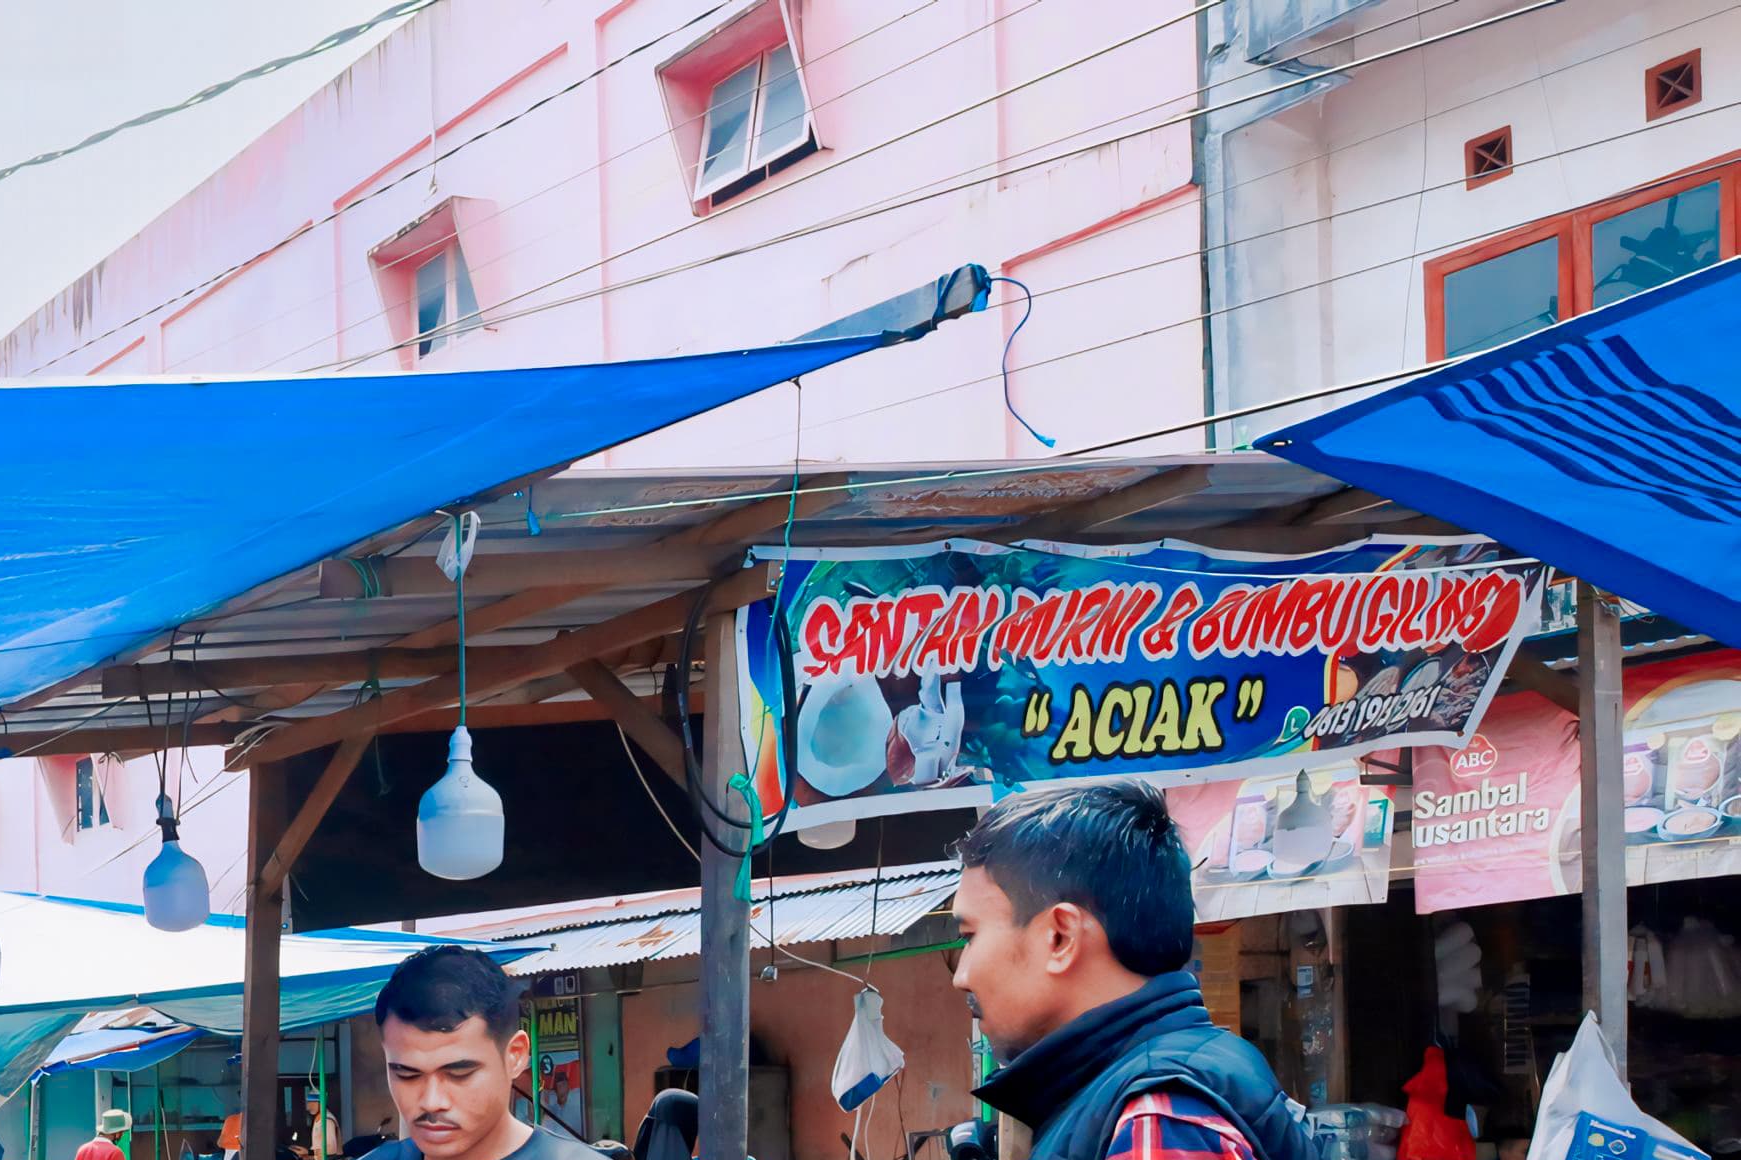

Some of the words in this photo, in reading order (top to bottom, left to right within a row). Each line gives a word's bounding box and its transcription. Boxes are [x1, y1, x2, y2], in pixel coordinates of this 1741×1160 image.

[804, 591, 999, 677] SANTAN
[992, 586, 1156, 662] MURNI
[1143, 588, 1198, 653] &
[1192, 577, 1370, 652] BUMBU
[1363, 573, 1520, 652] GILING
[1456, 750, 1492, 768] ABC
[1415, 772, 1527, 820] Sambal
[1412, 808, 1549, 848] usantara
